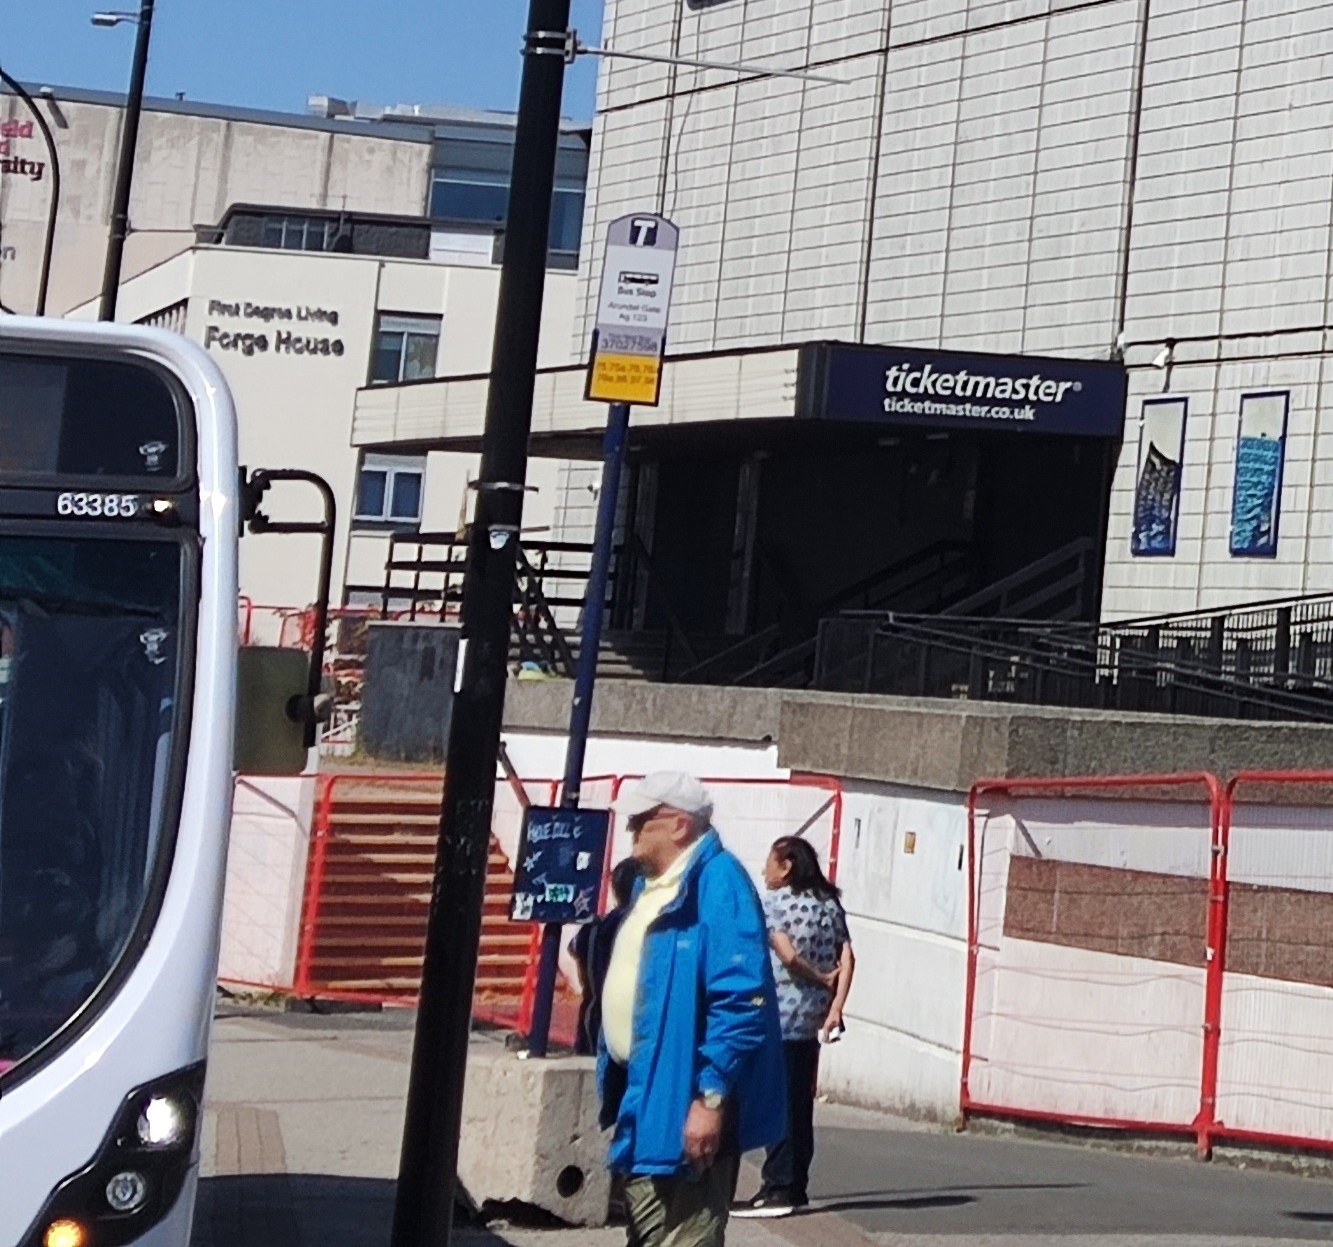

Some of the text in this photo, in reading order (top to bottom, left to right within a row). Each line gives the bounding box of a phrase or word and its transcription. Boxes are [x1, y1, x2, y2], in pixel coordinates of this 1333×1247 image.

[204, 325, 344, 357] Forge House
[884, 397, 1036, 421] ticketmaster.co.uk
[57, 492, 137, 517] 63385
